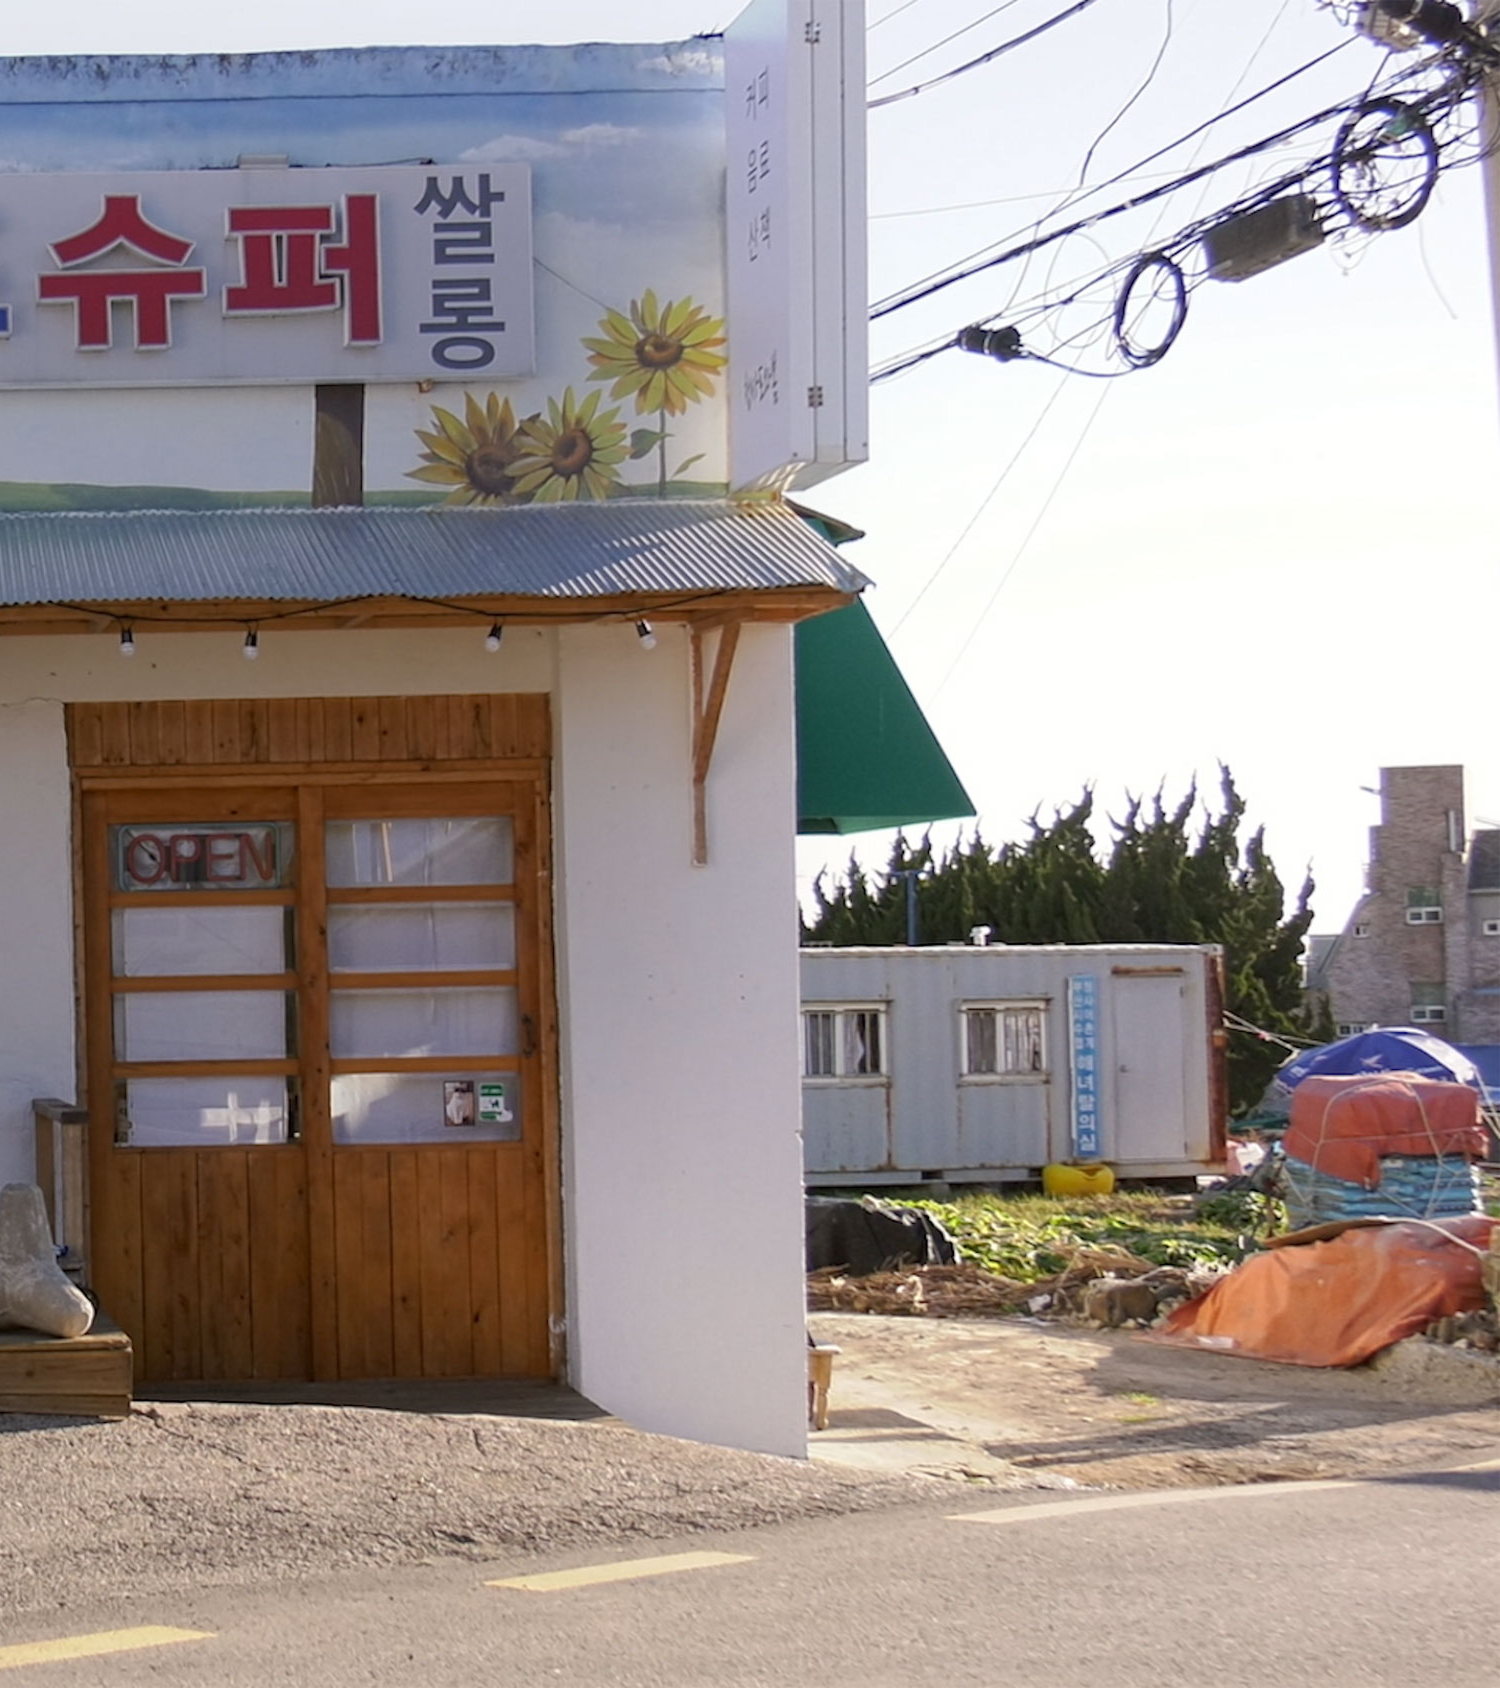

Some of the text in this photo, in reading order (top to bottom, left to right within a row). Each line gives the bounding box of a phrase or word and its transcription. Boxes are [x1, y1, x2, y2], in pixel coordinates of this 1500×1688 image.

[745, 66, 771, 121] 커피
[746, 139, 772, 195] 음료
[412, 172, 506, 371] 쌀롱
[128, 832, 274, 884] OPEN
